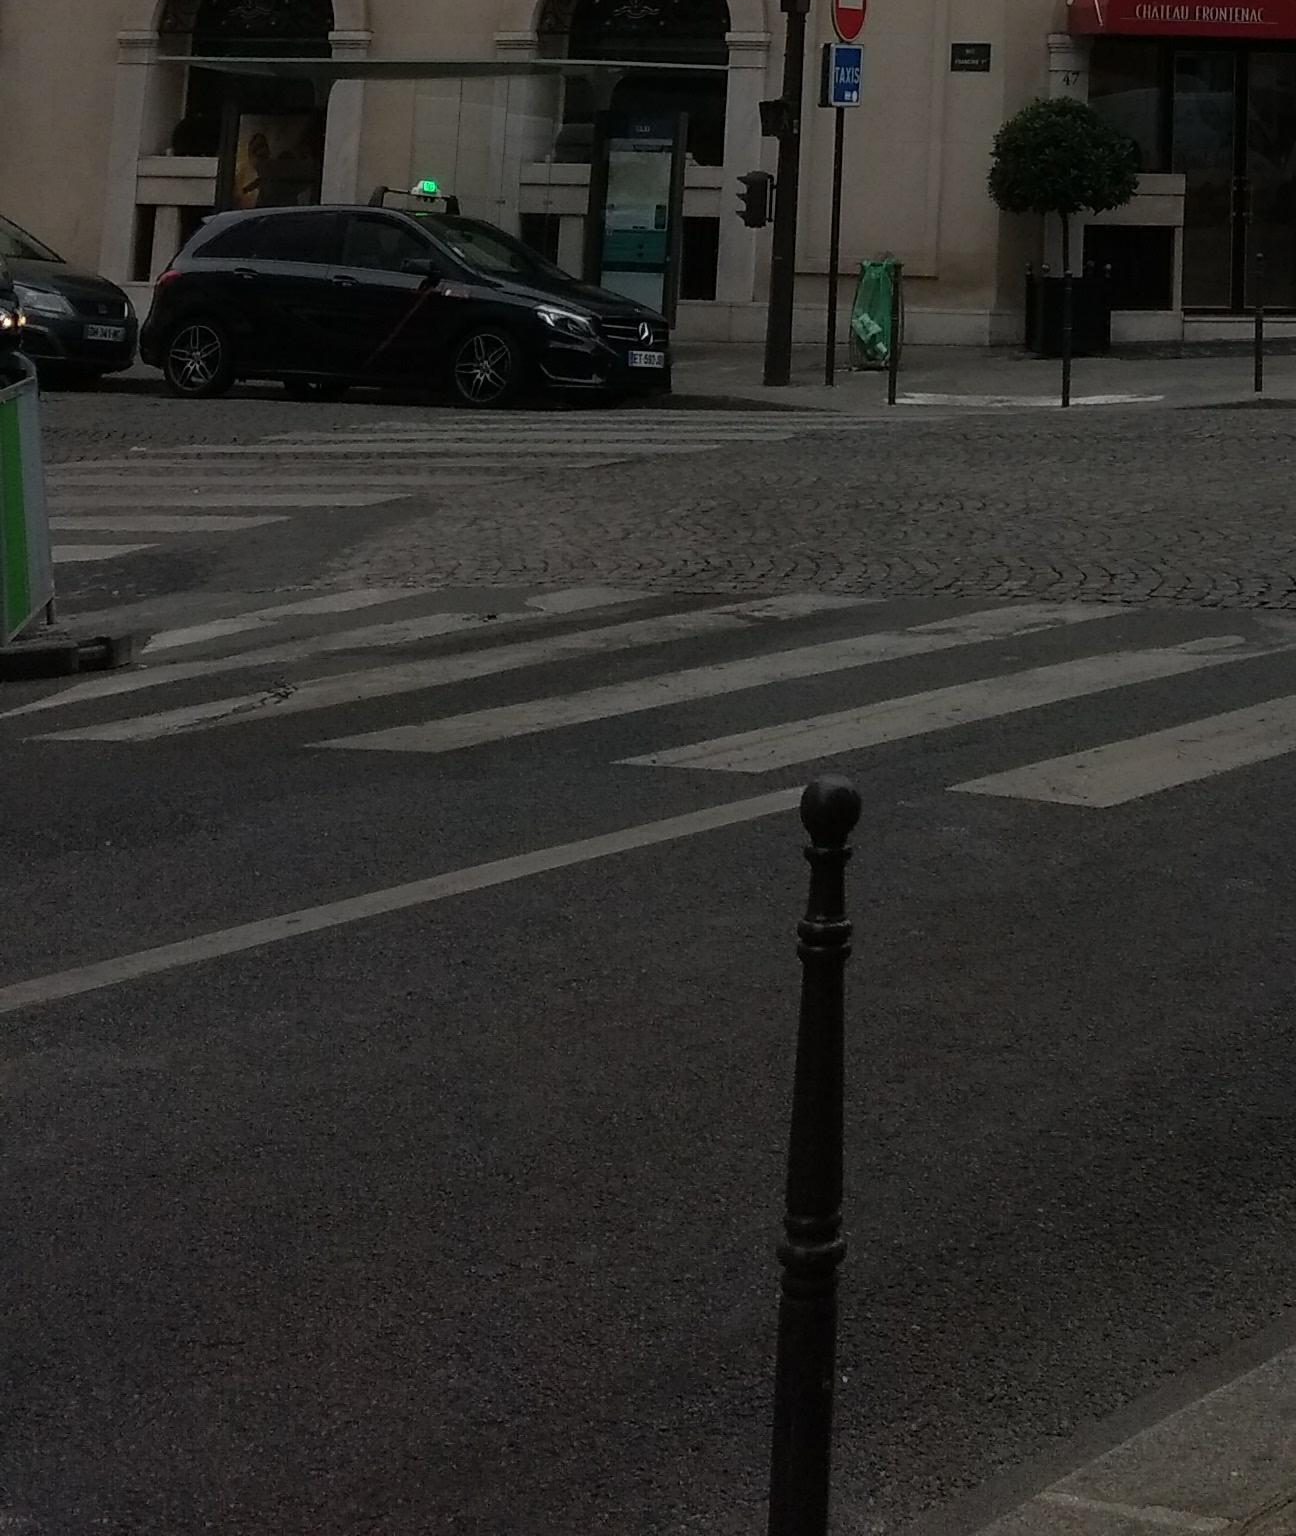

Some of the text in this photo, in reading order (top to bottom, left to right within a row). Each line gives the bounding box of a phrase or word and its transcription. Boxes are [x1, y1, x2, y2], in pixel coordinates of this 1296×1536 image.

[1195, 5, 1264, 23] FRONTENAC
[835, 66, 860, 84] TAXIS
[1062, 71, 1080, 86] 47
